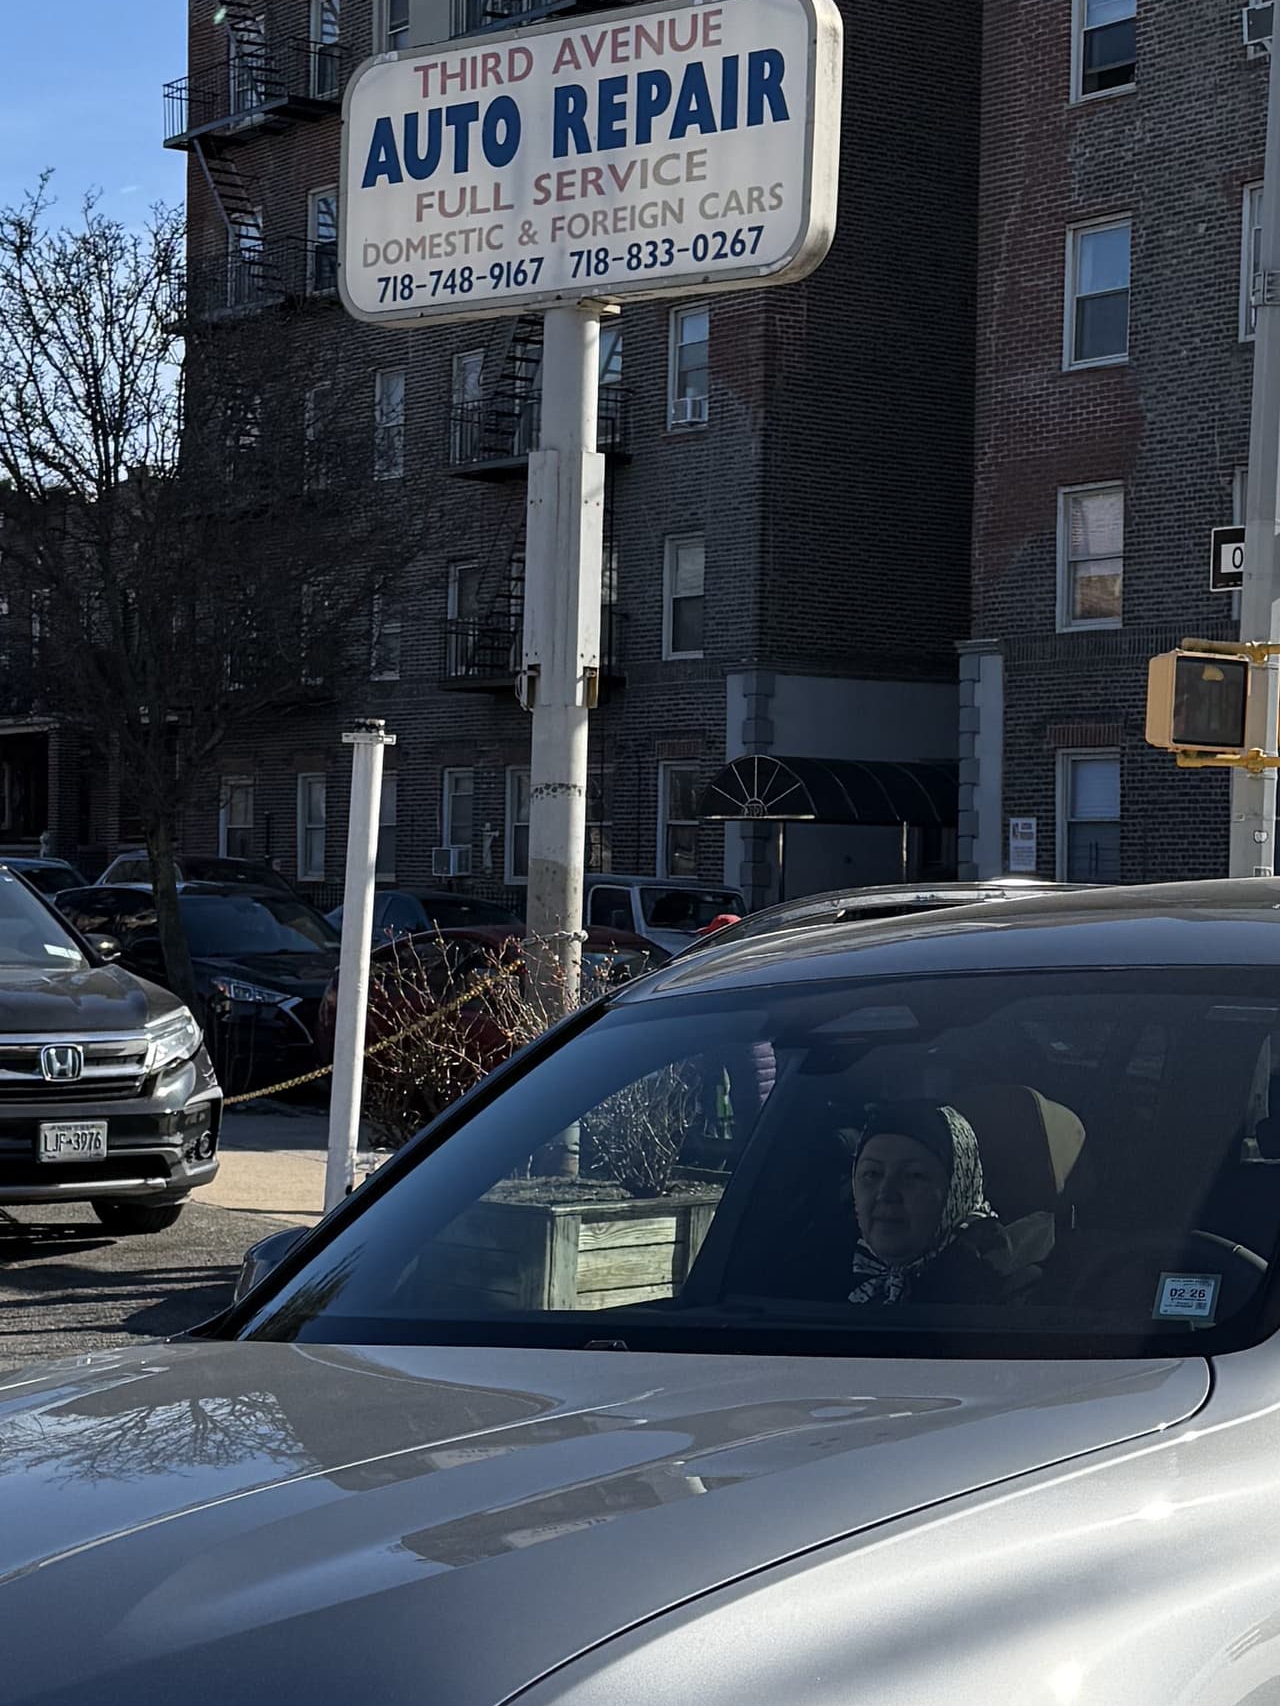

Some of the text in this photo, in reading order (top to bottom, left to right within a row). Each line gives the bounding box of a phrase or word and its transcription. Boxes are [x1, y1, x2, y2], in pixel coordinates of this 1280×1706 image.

[414, 9, 723, 98] THIRD AVENUE
[361, 48, 791, 189] AUTO REPAIR
[363, 182, 783, 268] DOMESTIC & FOREIGN CARS
[416, 149, 708, 223] FULL SERVICE
[377, 226, 765, 303] 718-748-9167 718-833-0267
